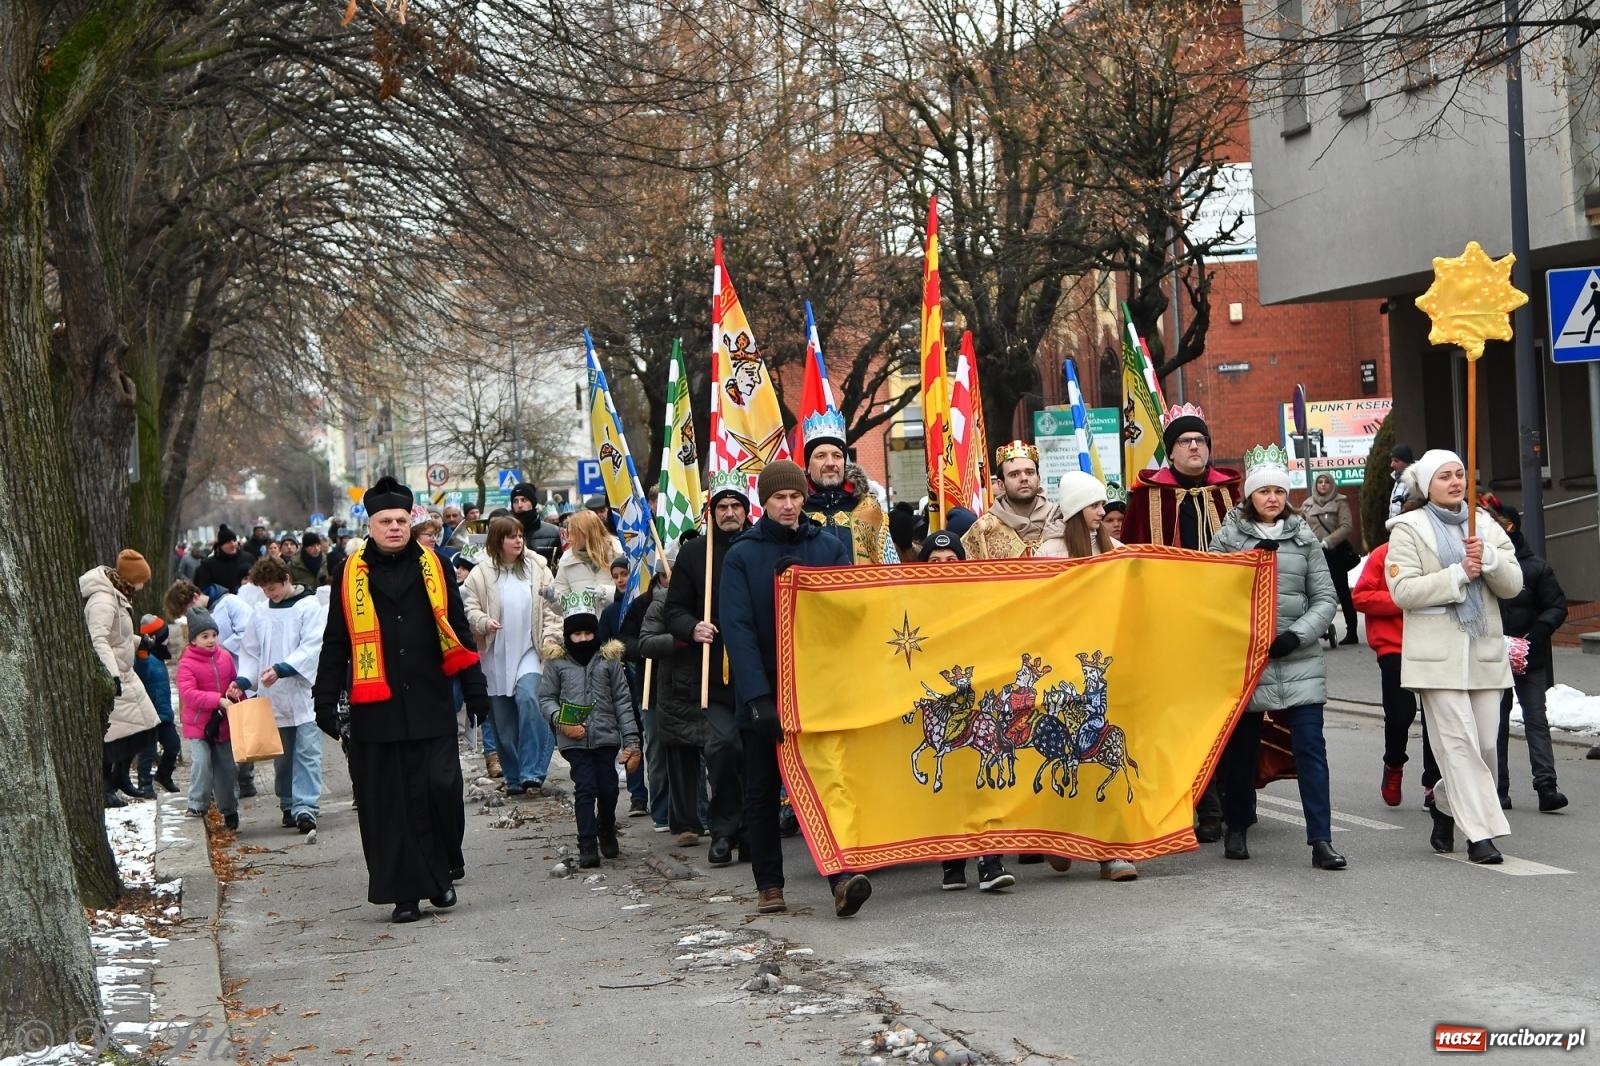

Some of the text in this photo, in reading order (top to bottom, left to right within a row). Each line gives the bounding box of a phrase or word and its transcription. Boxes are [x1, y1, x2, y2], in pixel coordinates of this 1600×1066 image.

[1310, 402, 1352, 413] PUNKT
[429, 469, 446, 481] 40
[584, 462, 600, 485] P
[1312, 469, 1342, 480] BRO
[356, 563, 369, 615] KRÓLI
